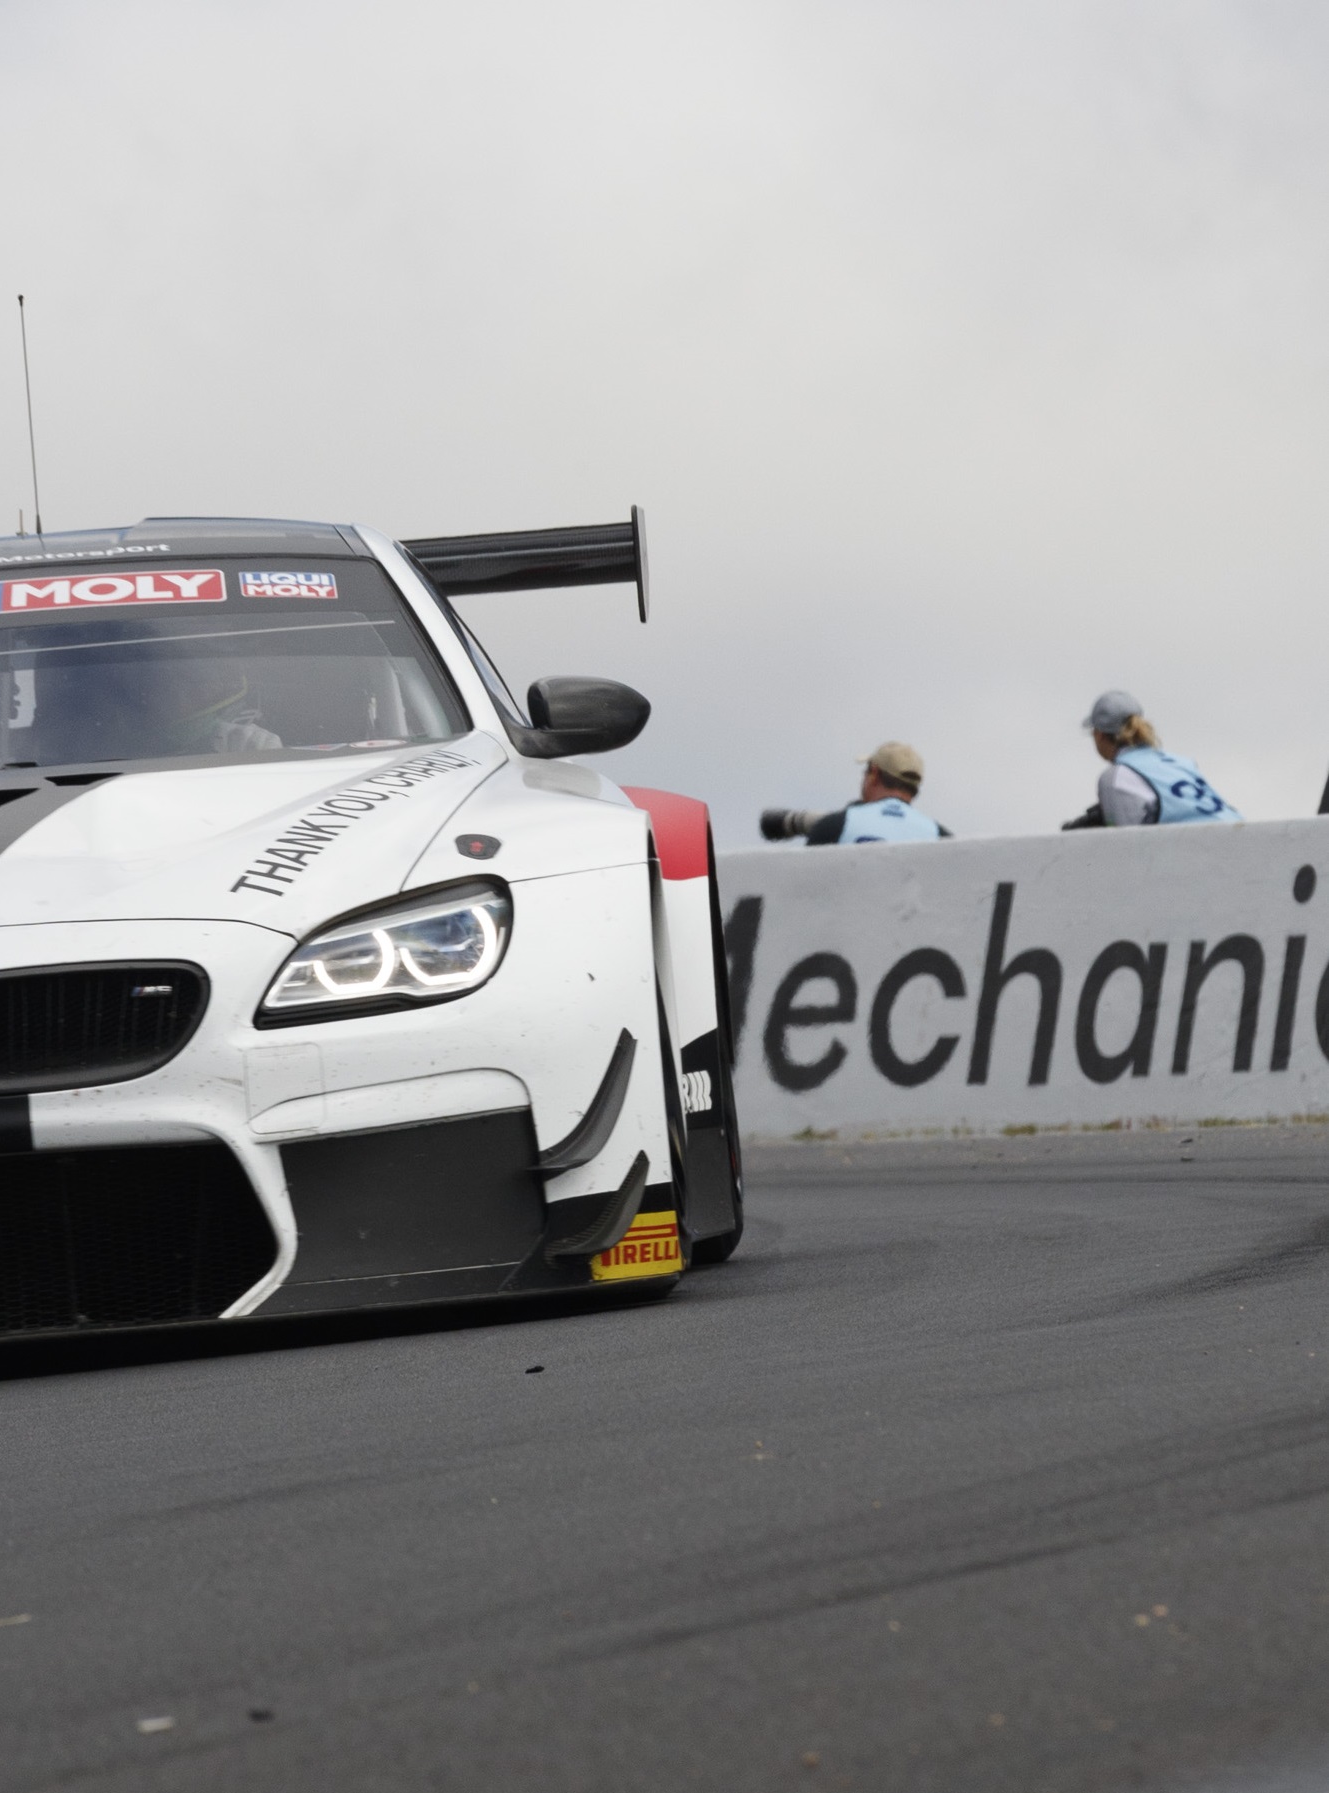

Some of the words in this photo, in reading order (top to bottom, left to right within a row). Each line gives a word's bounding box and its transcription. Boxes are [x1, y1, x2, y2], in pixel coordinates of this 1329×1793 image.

[10, 573, 216, 607] MOLY
[244, 572, 331, 586] LIQUI
[246, 584, 336, 598] MOLY
[230, 818, 349, 897] THANK
[307, 787, 410, 819] YOU,
[725, 863, 1329, 1094] echani
